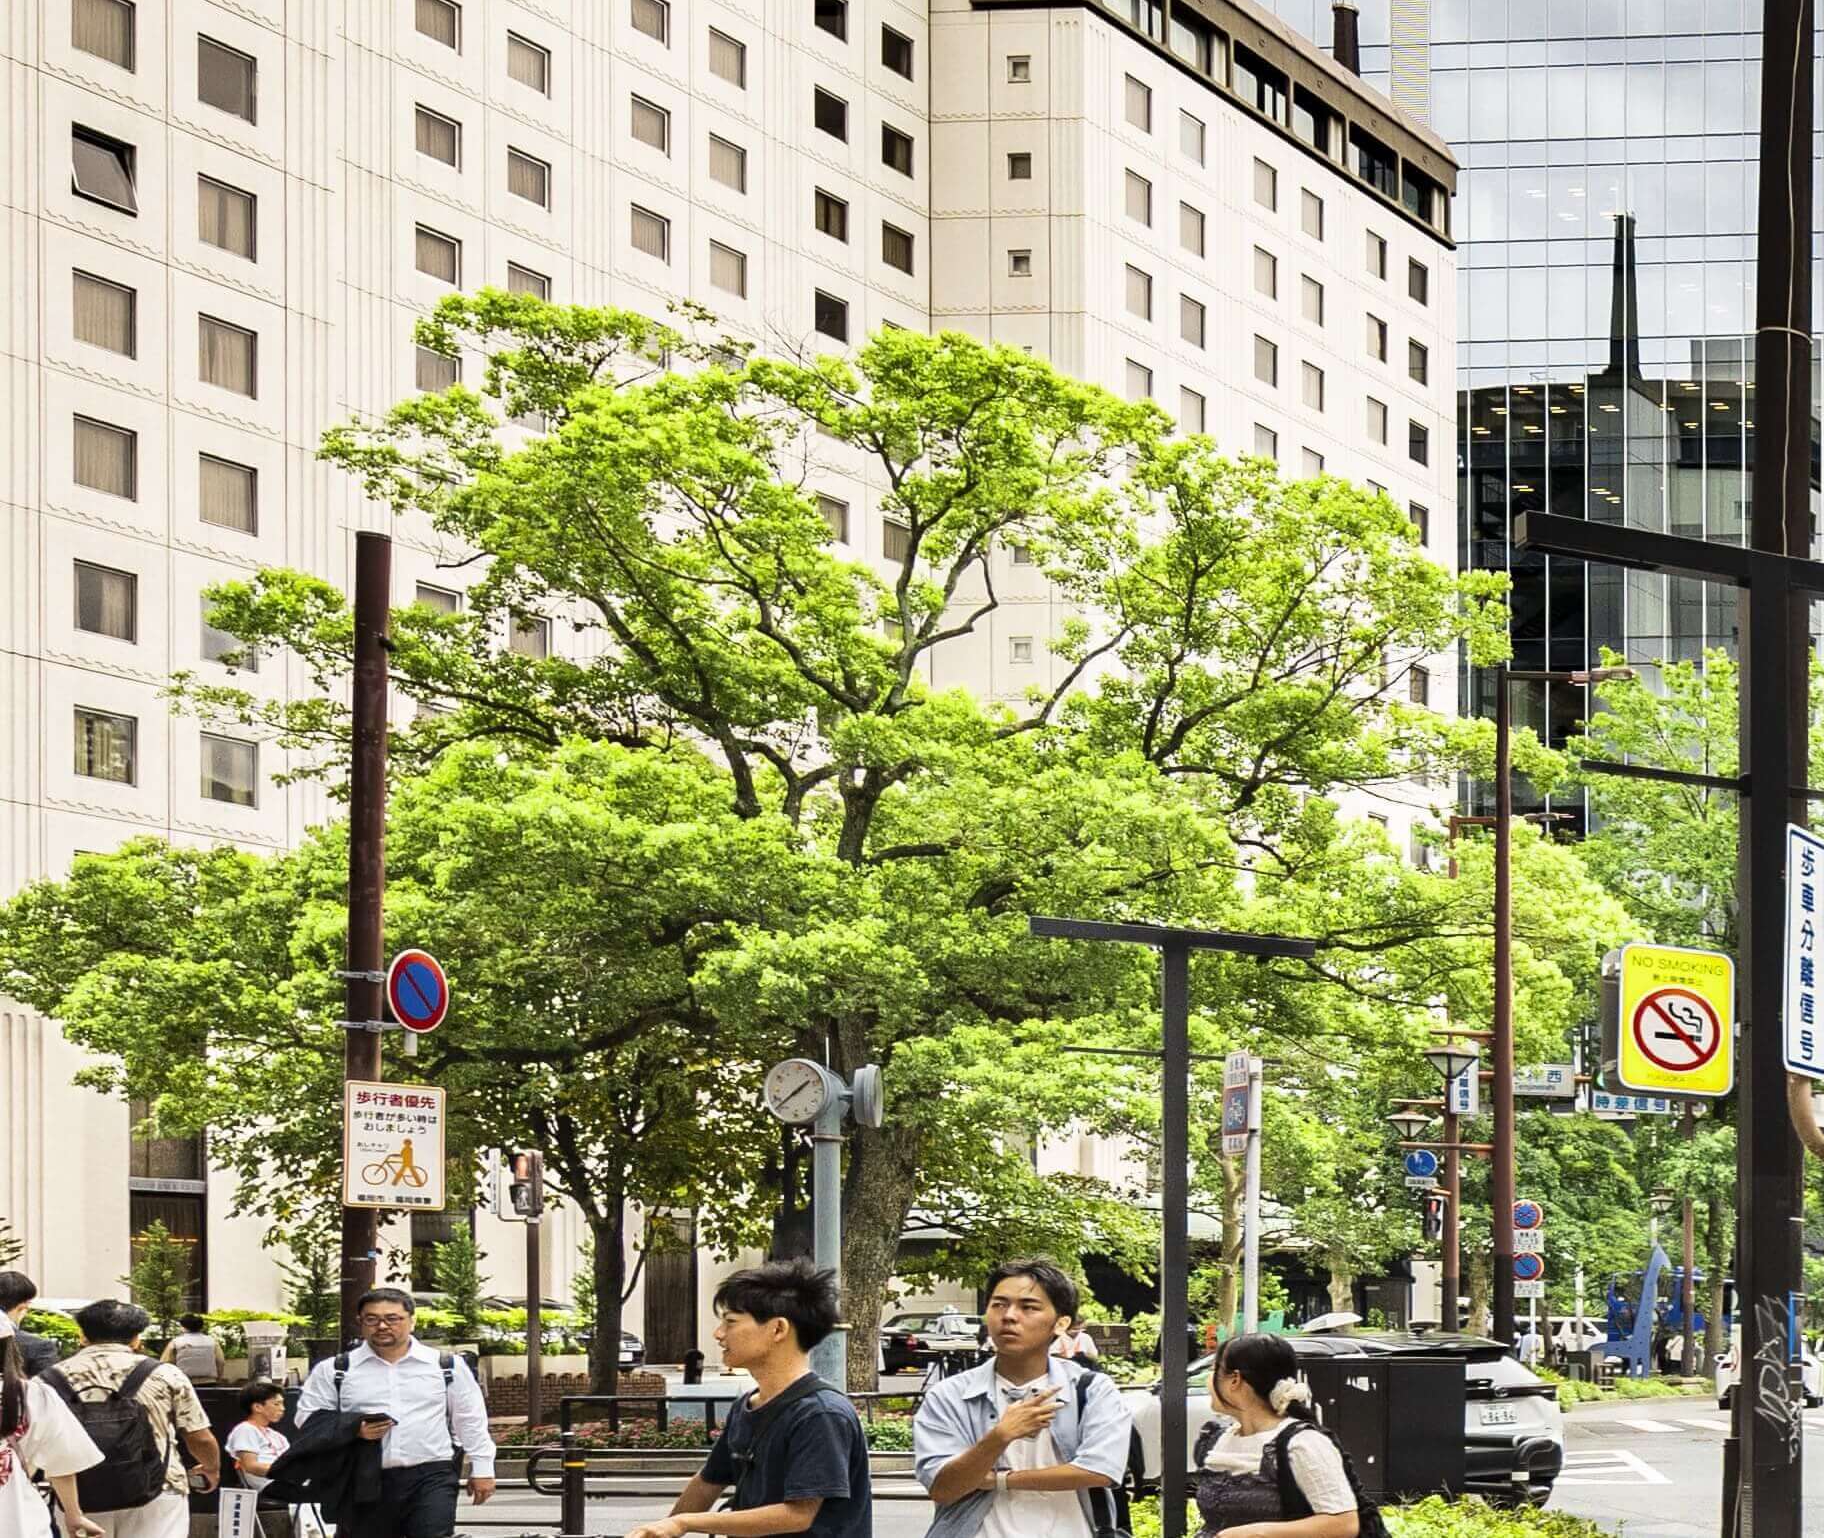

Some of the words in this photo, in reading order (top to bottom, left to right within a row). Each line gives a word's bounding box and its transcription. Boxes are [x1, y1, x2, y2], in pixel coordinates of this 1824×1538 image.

[1799, 846, 1816, 1062] 歩車分離信号
[1632, 955, 1654, 967] NO
[1657, 958, 1724, 976] SMOKING
[356, 1091, 436, 1109] 歩行者優先
[1595, 1095, 1666, 1111] 時差信号
